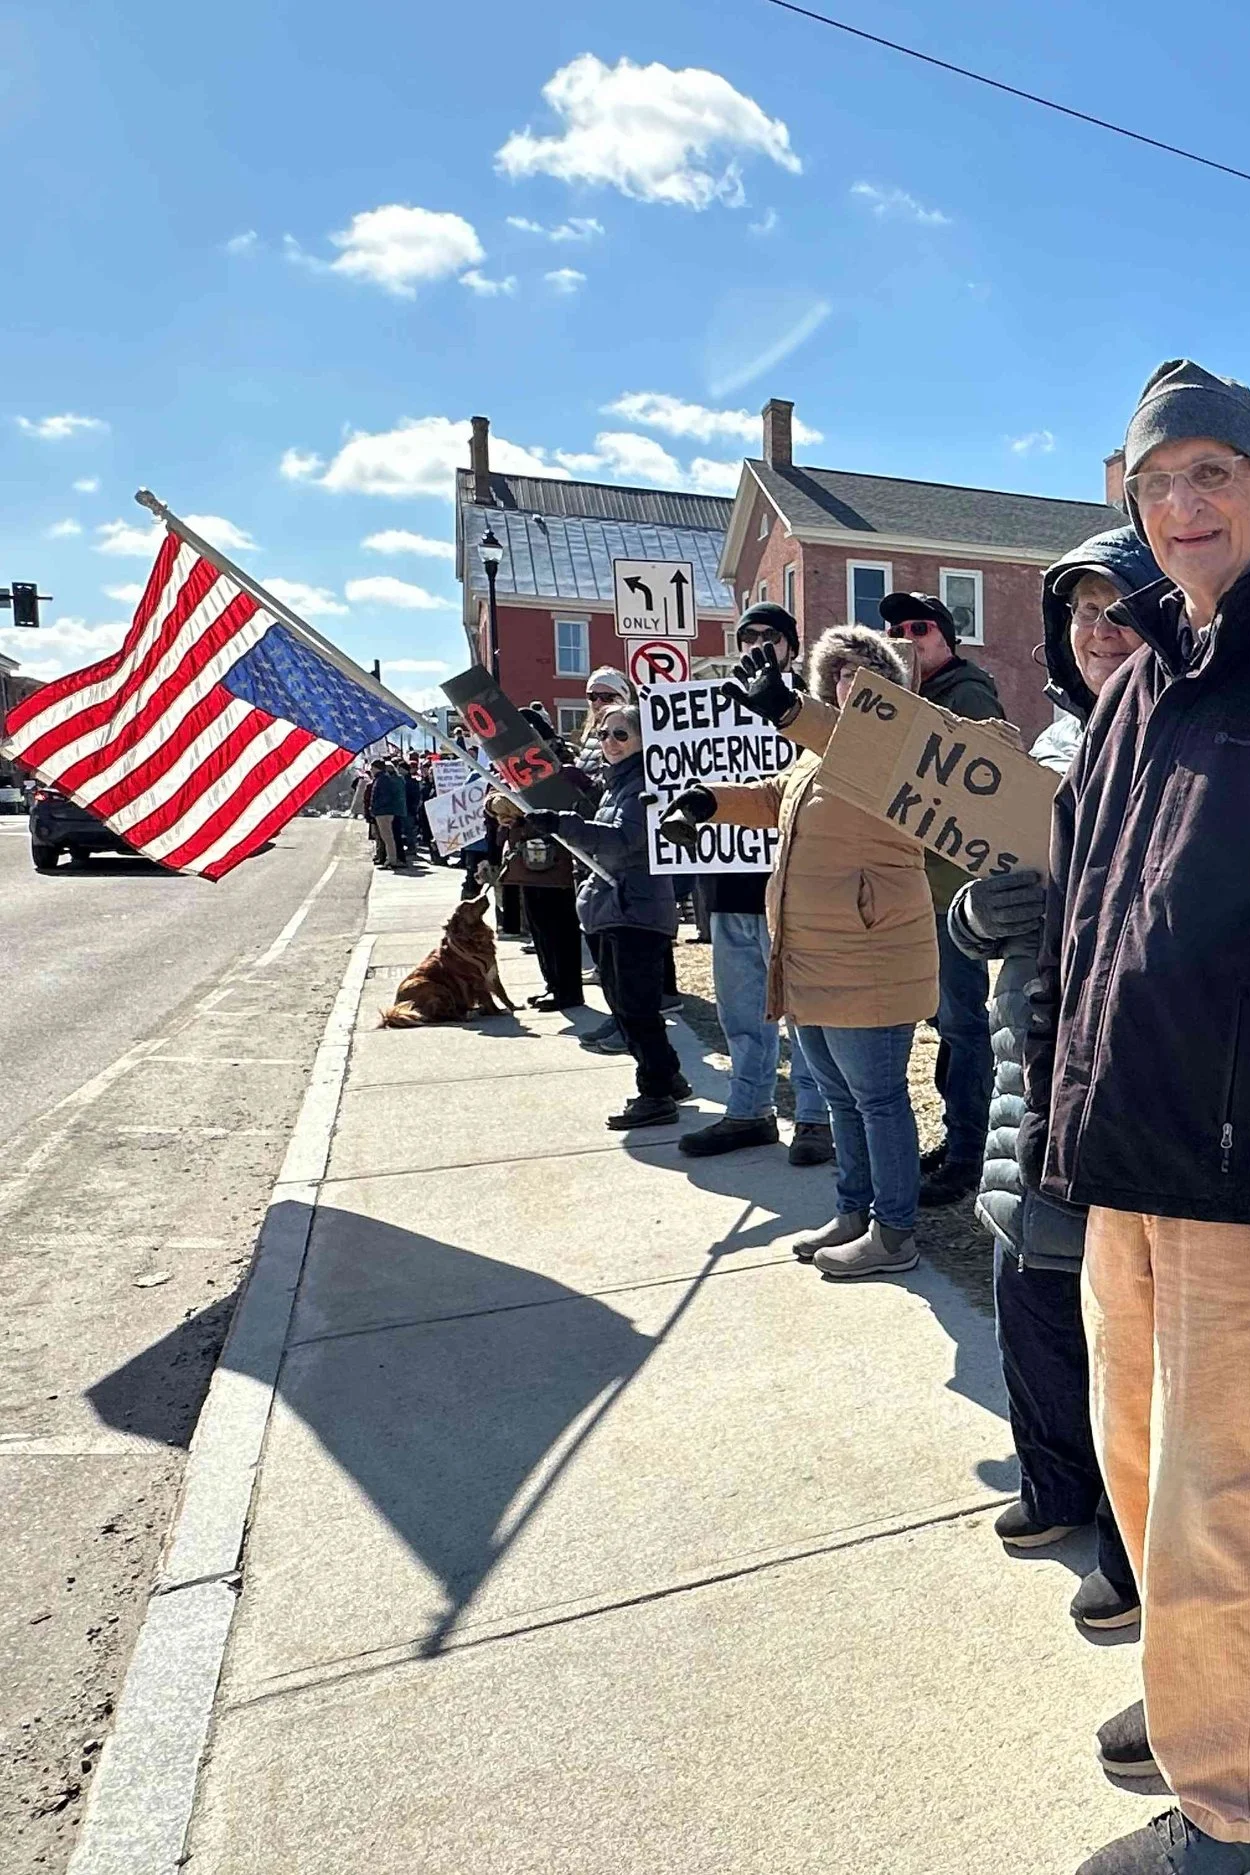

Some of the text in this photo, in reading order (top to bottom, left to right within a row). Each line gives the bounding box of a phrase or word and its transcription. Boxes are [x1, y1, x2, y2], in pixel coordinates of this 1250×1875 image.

[623, 617, 660, 630] ONLY
[639, 685, 769, 731] "DEEPL
[646, 735, 793, 784] CONCERNED
[916, 731, 1002, 795] NO
[451, 786, 484, 814] NO
